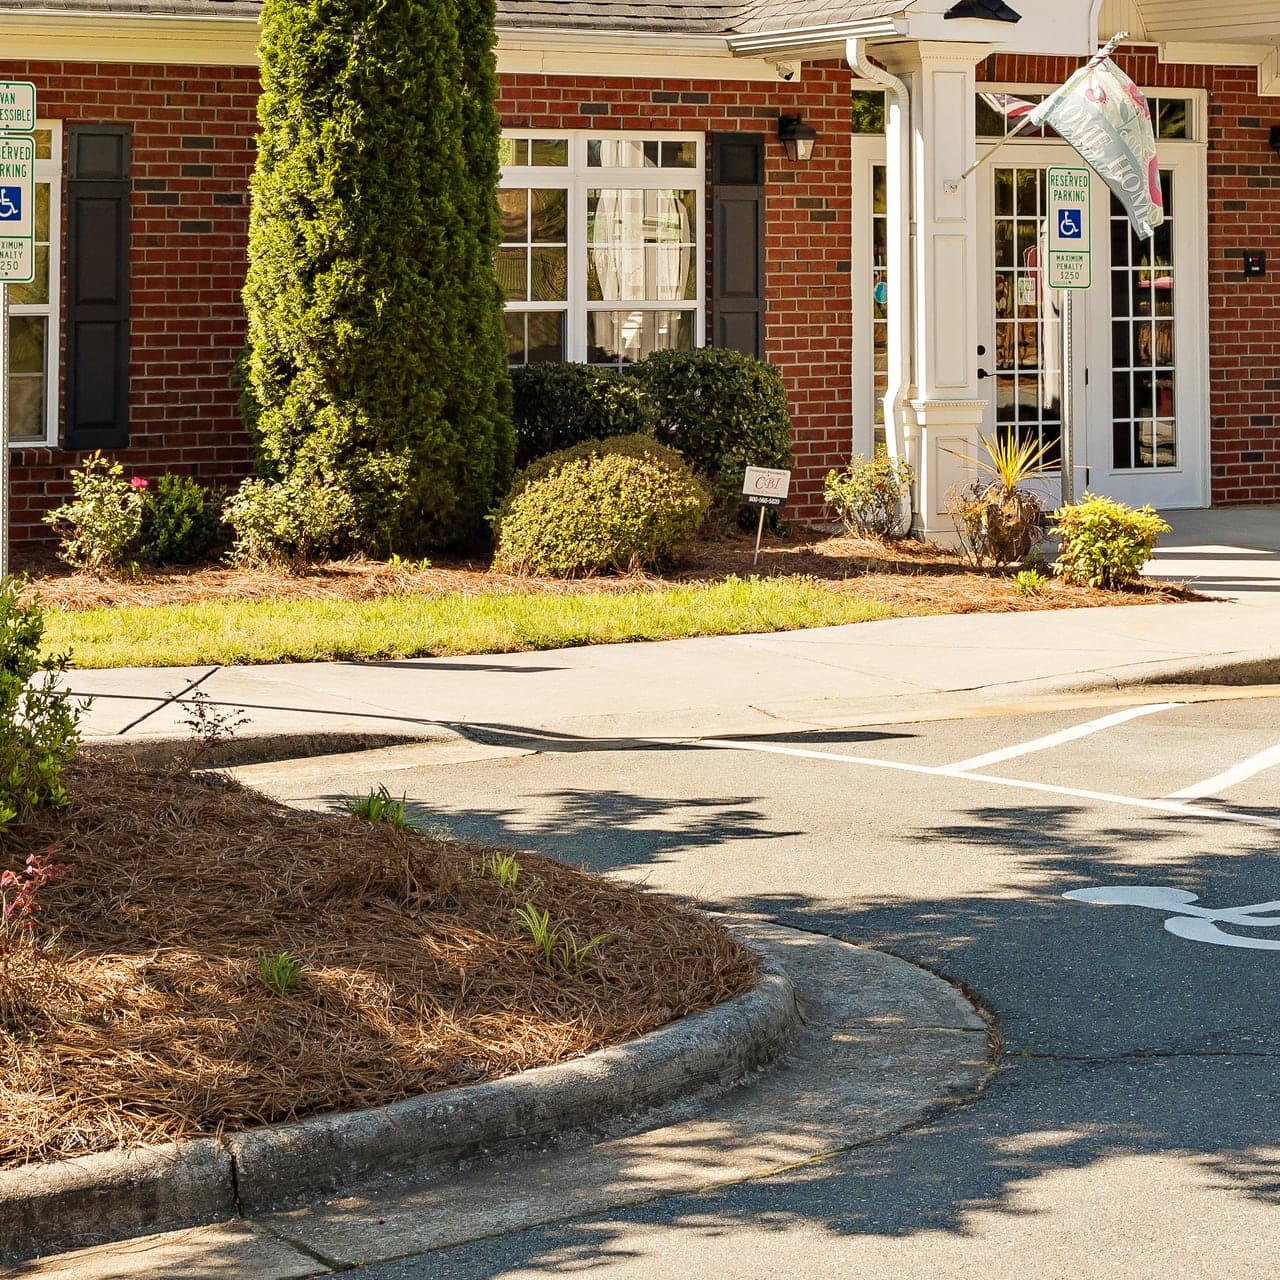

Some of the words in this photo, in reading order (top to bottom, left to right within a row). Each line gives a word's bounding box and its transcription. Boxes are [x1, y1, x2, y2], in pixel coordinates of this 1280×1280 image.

[0, 92, 16, 105] VAN
[1050, 175, 1088, 188] RESERVED
[1053, 189, 1085, 202] PARKING
